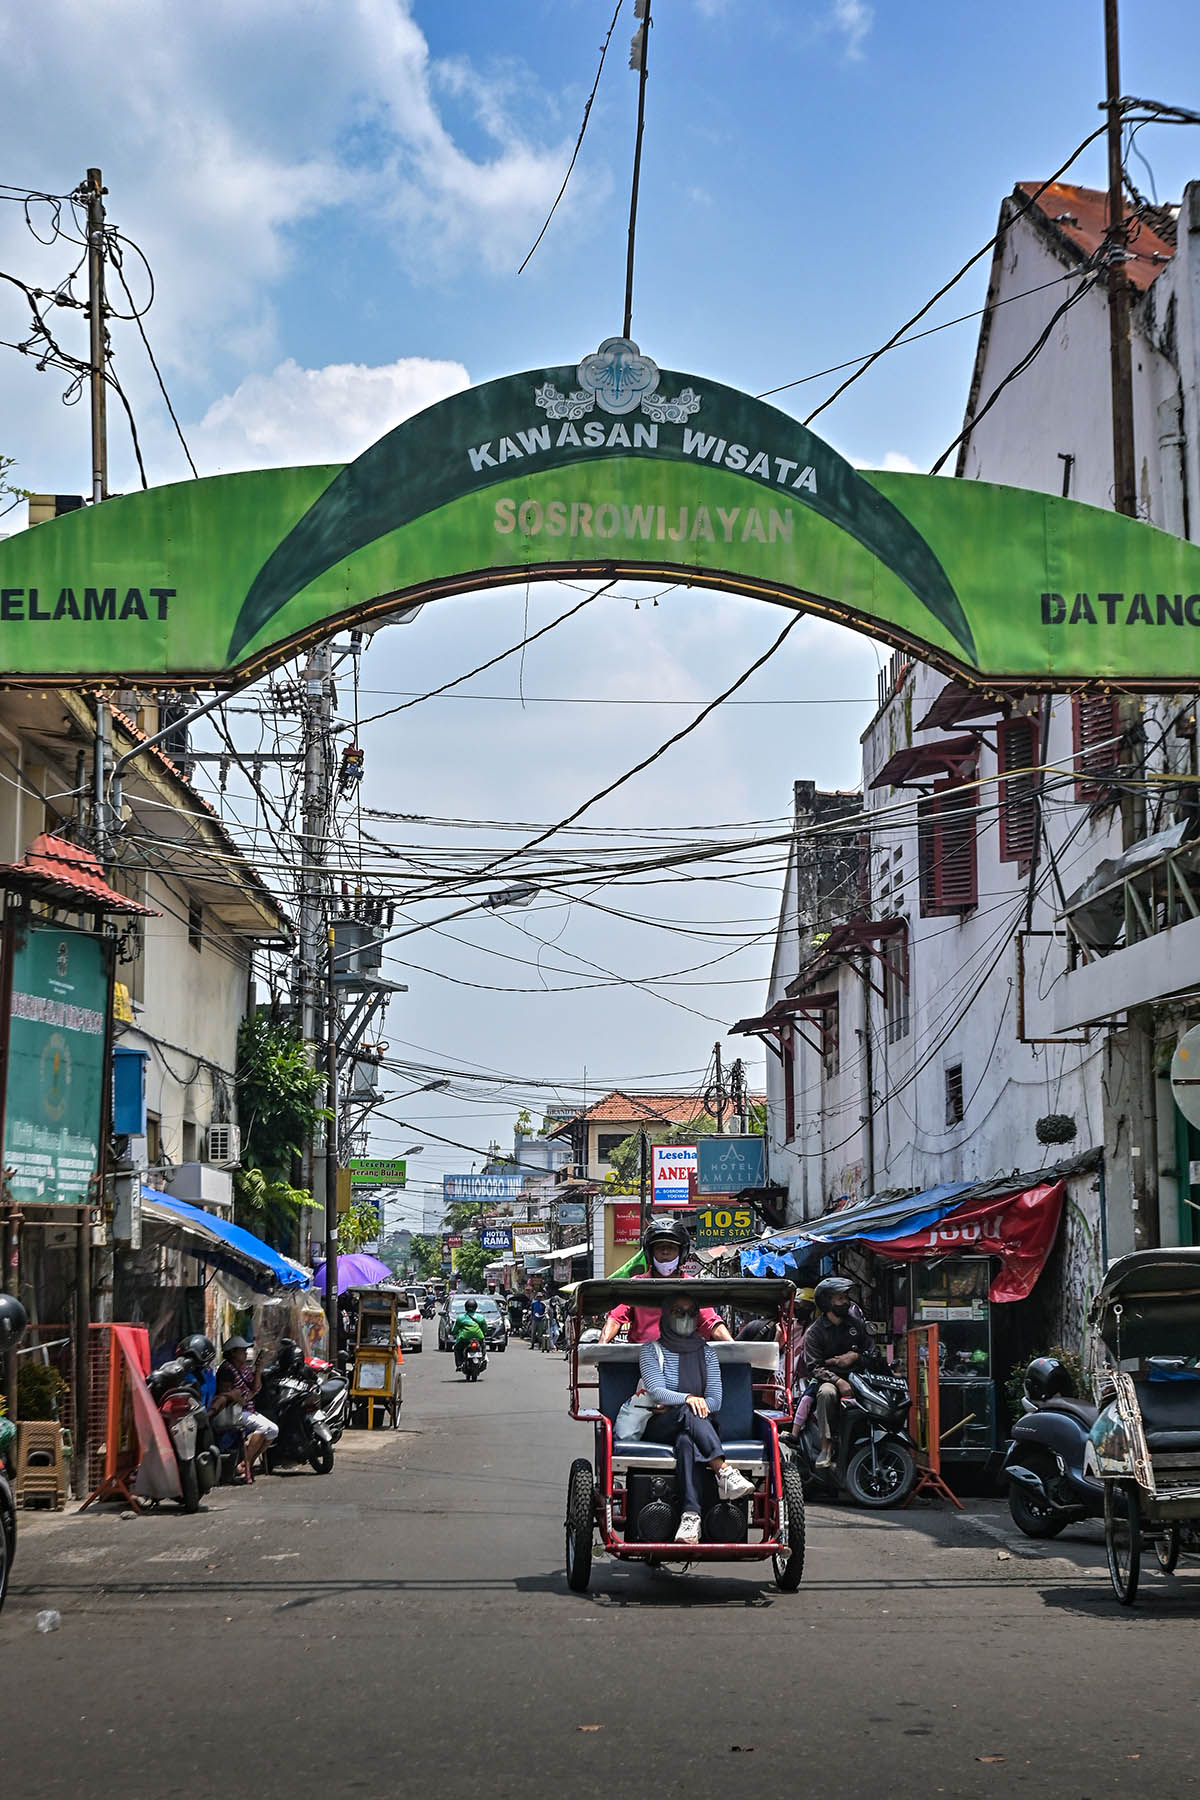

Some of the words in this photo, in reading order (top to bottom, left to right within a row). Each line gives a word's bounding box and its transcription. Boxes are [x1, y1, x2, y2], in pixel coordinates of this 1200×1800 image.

[468, 421, 659, 472] KAWASAN
[682, 427, 818, 494] WISATA
[493, 498, 794, 544] SOSROWIJAYAN
[1, 588, 177, 621] ELAMAT
[359, 1160, 396, 1168] Lesehan
[352, 1169, 379, 1177] Terang
[380, 1169, 404, 1177] Bulan
[702, 1173, 762, 1183] AMALIA
[454, 1177, 505, 1198] MALIOBORO
[507, 1177, 522, 1197] INN
[699, 1210, 751, 1228] 105
[699, 1229, 725, 1237] HOME
[729, 1229, 751, 1237] STAY
[483, 1237, 510, 1246] RAMA
